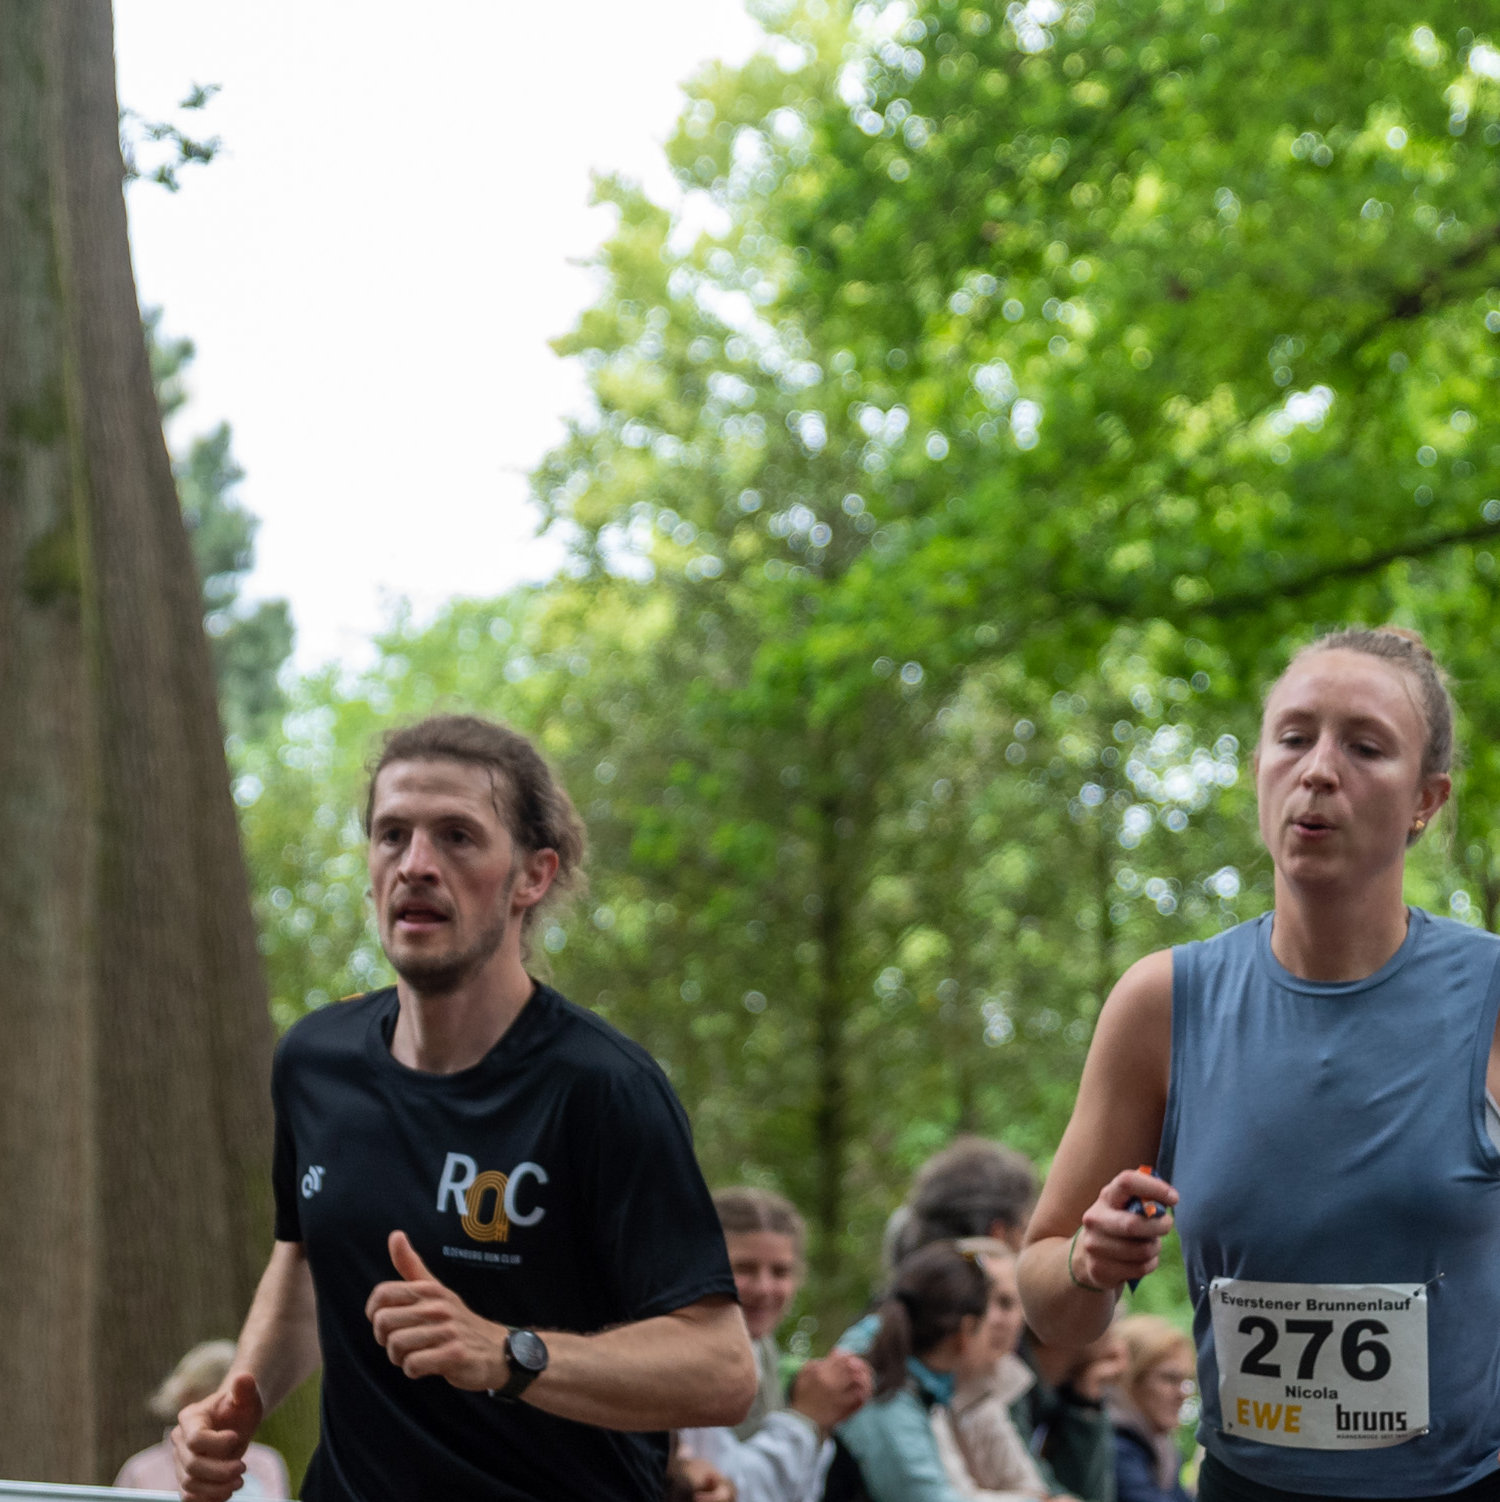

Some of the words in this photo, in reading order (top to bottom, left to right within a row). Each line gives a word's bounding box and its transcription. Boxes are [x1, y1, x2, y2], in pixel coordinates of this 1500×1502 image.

[1220, 1292, 1301, 1311] Everstener
[1306, 1298, 1411, 1311] Brunnenlauf
[1238, 1315, 1391, 1382] 276
[1285, 1385, 1338, 1400] Nicola
[1236, 1398, 1302, 1433] EWE
[1336, 1404, 1407, 1431] bruns
